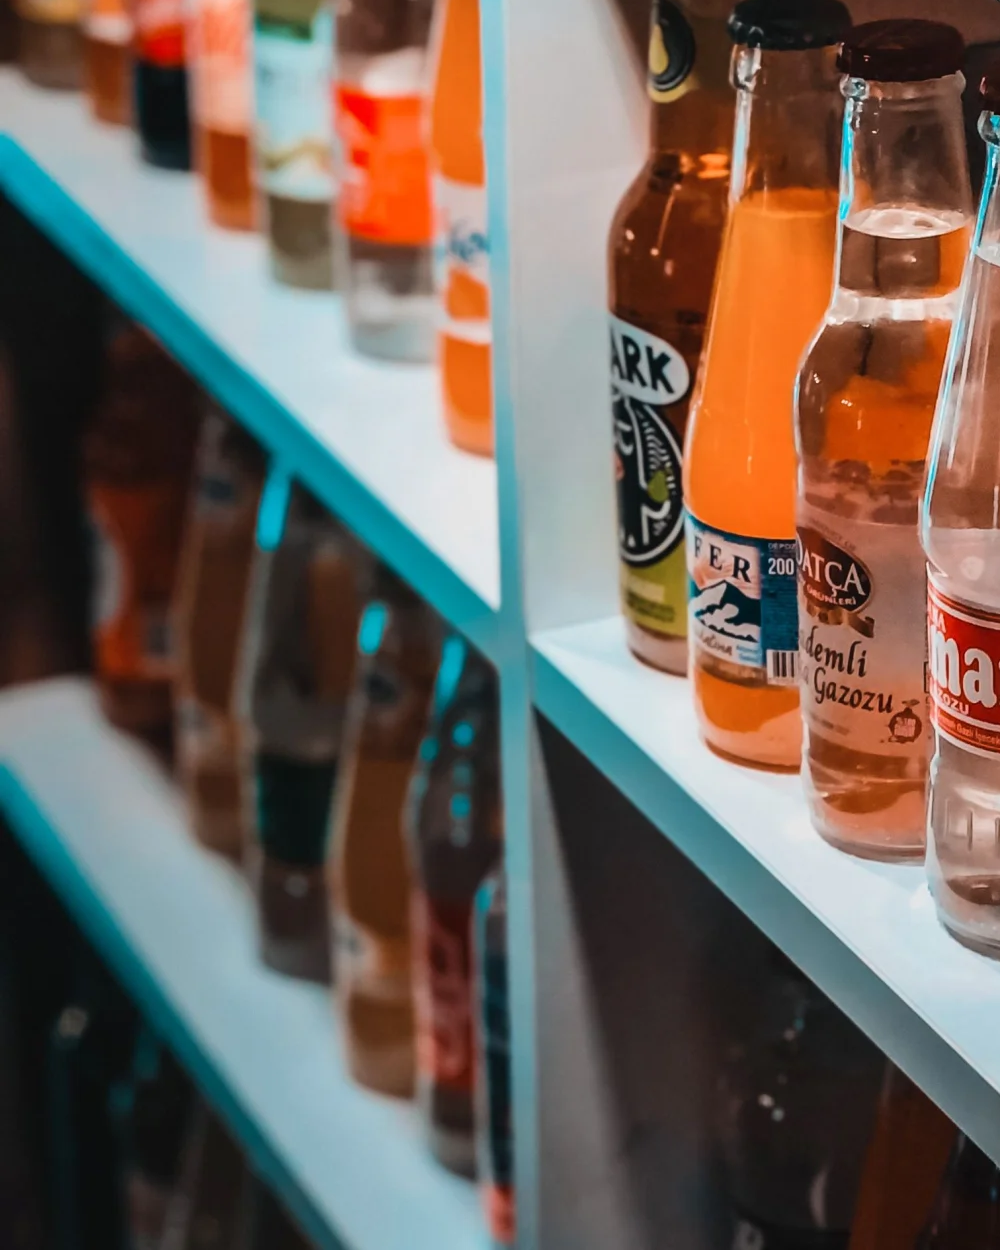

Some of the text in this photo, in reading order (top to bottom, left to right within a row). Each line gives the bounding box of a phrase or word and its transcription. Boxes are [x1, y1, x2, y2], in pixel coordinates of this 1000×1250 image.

[768, 557, 795, 576] 200
[801, 625, 867, 678] demli
[814, 665, 894, 714] Gazozu
